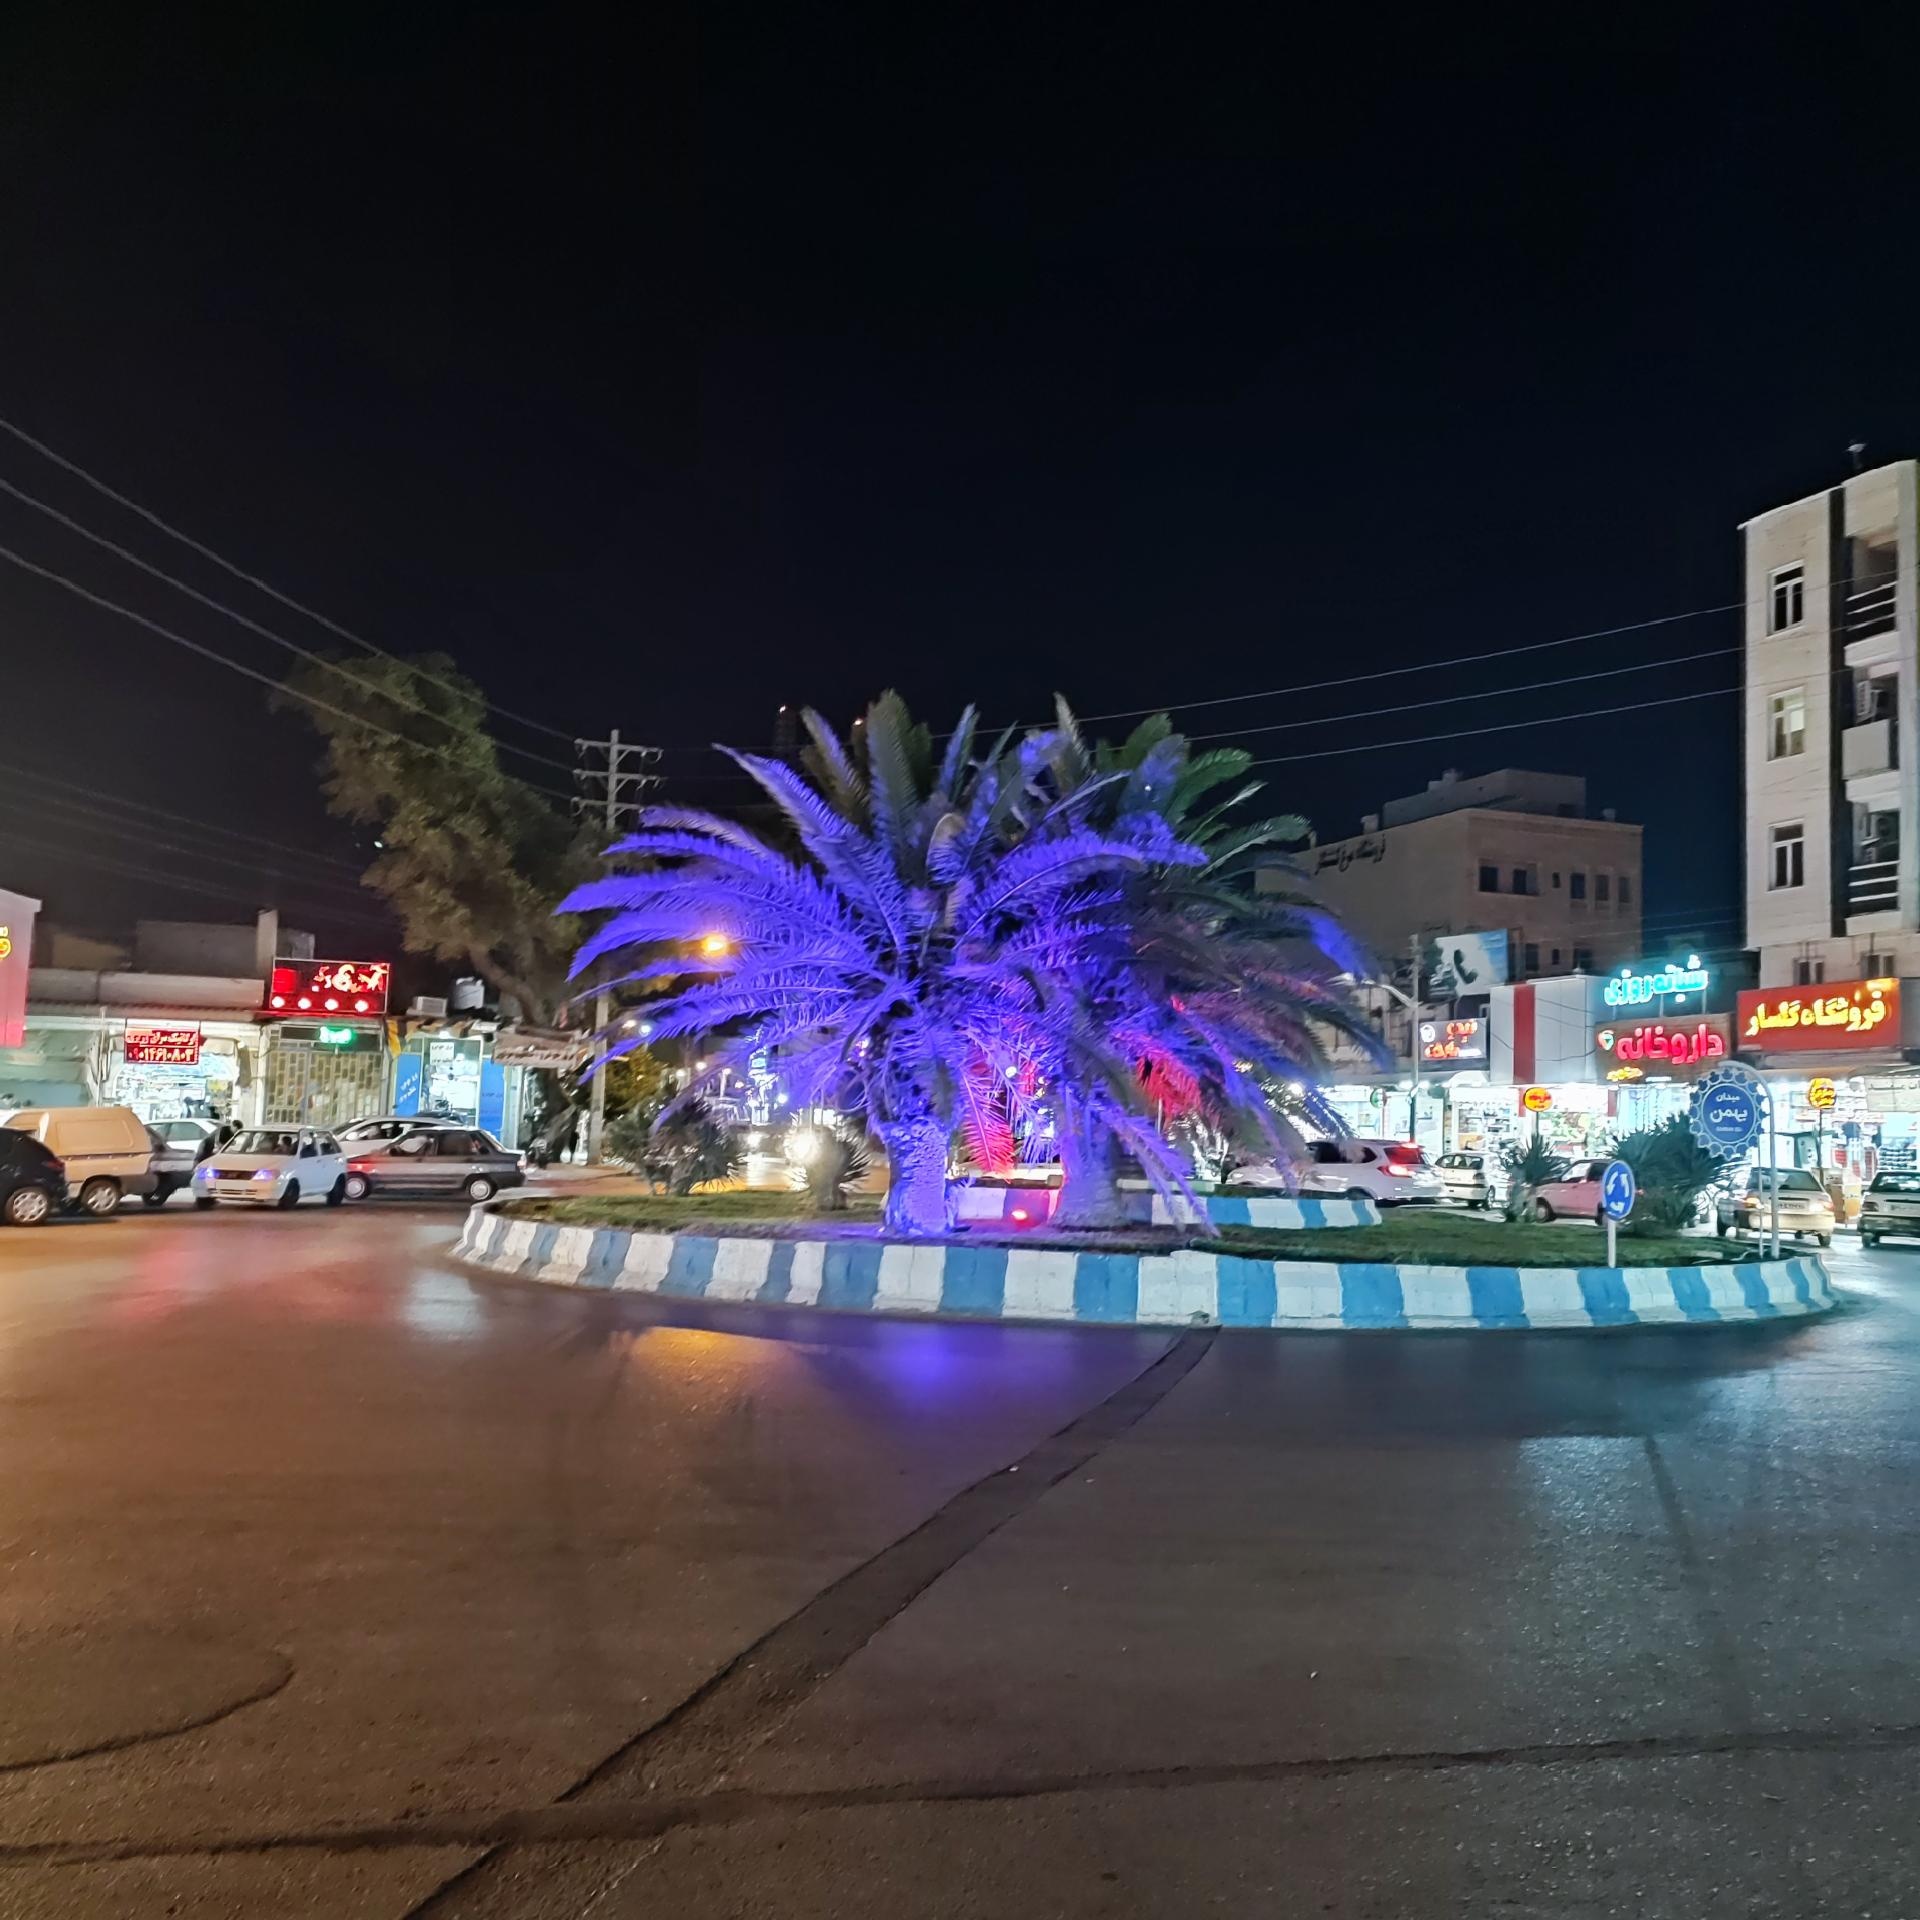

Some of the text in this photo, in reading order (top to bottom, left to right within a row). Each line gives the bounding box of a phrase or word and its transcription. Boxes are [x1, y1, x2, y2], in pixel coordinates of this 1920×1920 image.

[1604, 954, 1709, 1006] شبانه روزی
[1744, 989, 1886, 1037] فروشگاه گلسار
[1616, 1023, 1724, 1065] داروخانه
[1709, 1107, 1749, 1123] بهمن
[1715, 1091, 1741, 1103] میدان
